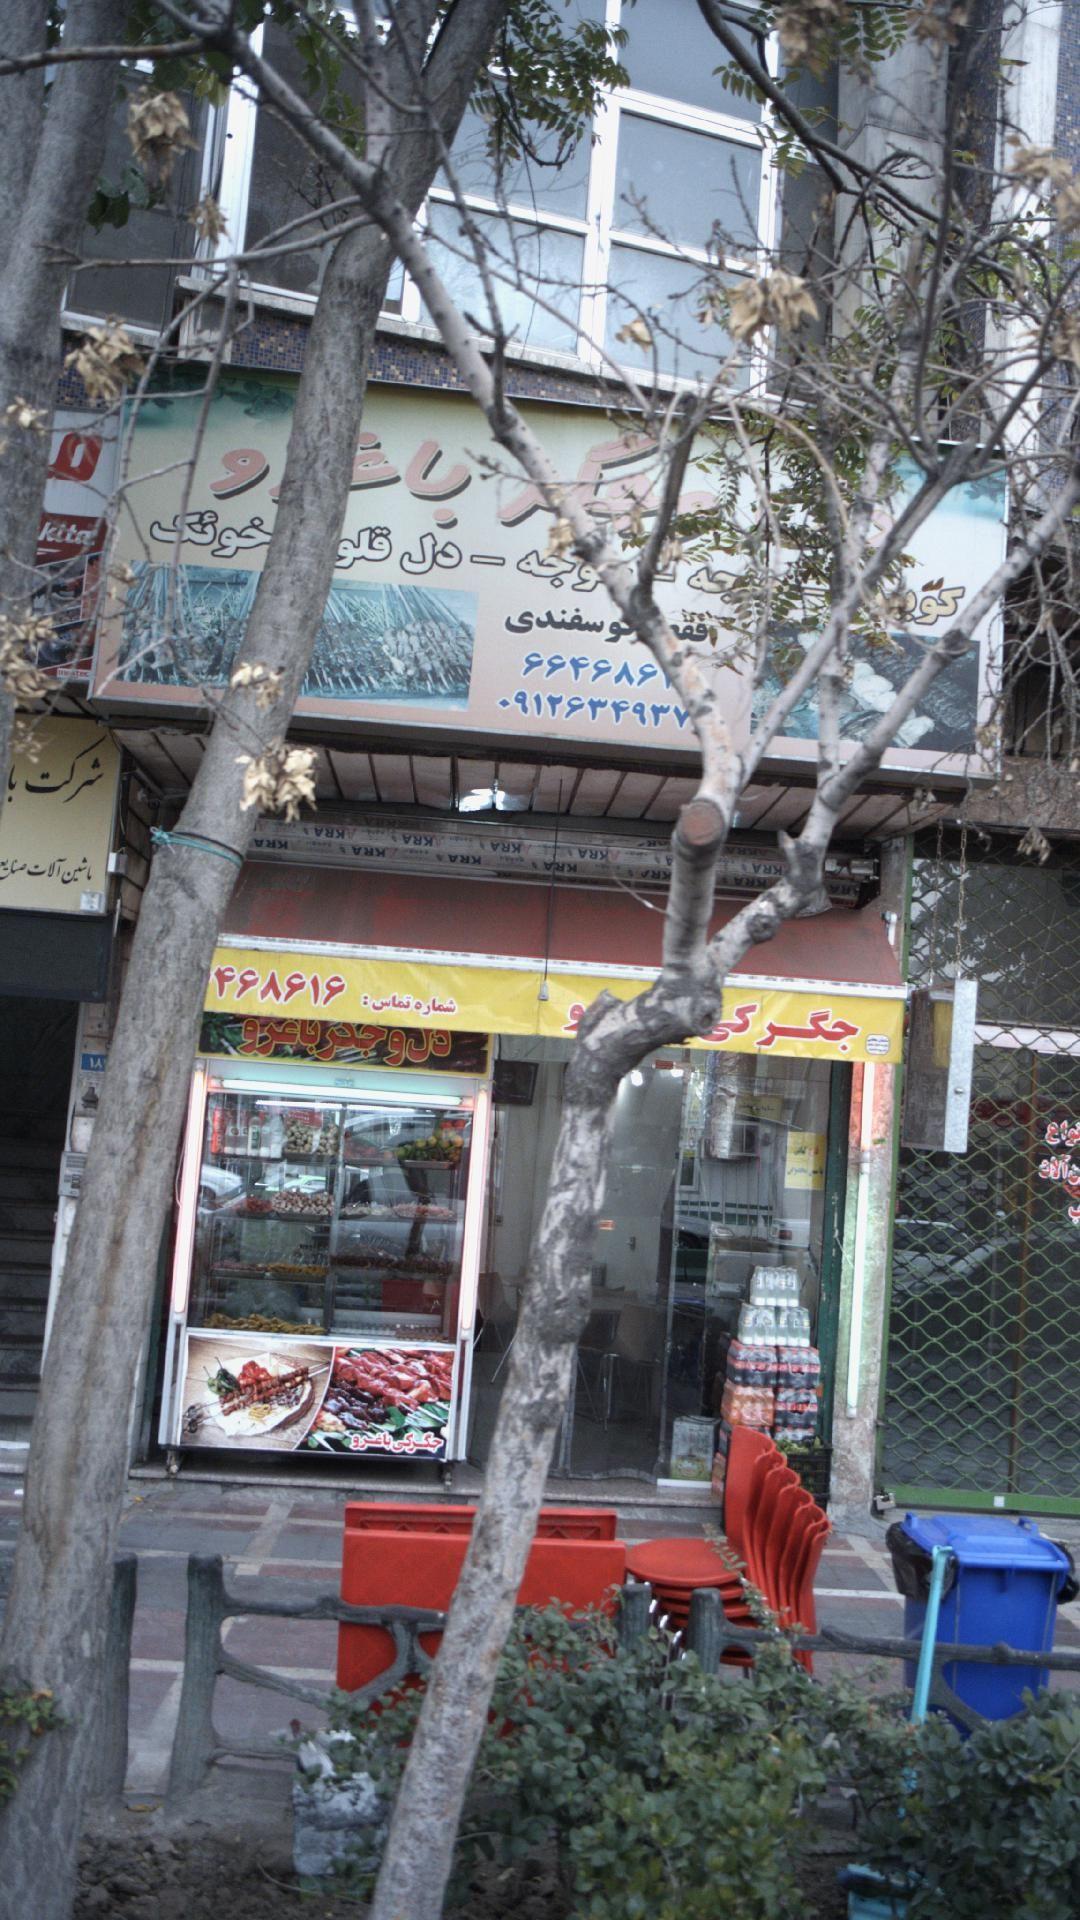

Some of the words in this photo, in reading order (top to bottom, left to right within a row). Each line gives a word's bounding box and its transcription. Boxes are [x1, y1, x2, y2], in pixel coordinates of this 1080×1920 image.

[209, 430, 473, 530] باغو
[38, 520, 93, 547] kita
[333, 526, 392, 569] قلو
[400, 532, 462, 575] دل
[517, 550, 602, 592] وجه
[522, 652, 672, 690] ۶۶۴۶۸۶۱
[499, 690, 689, 728] ۰۹۱۲۶۳۴۹۳۷
[25, 735, 106, 803] شرکت
[208, 966, 346, 1006] ۴۶۸۶۱۶
[412, 997, 456, 1016] شماره
